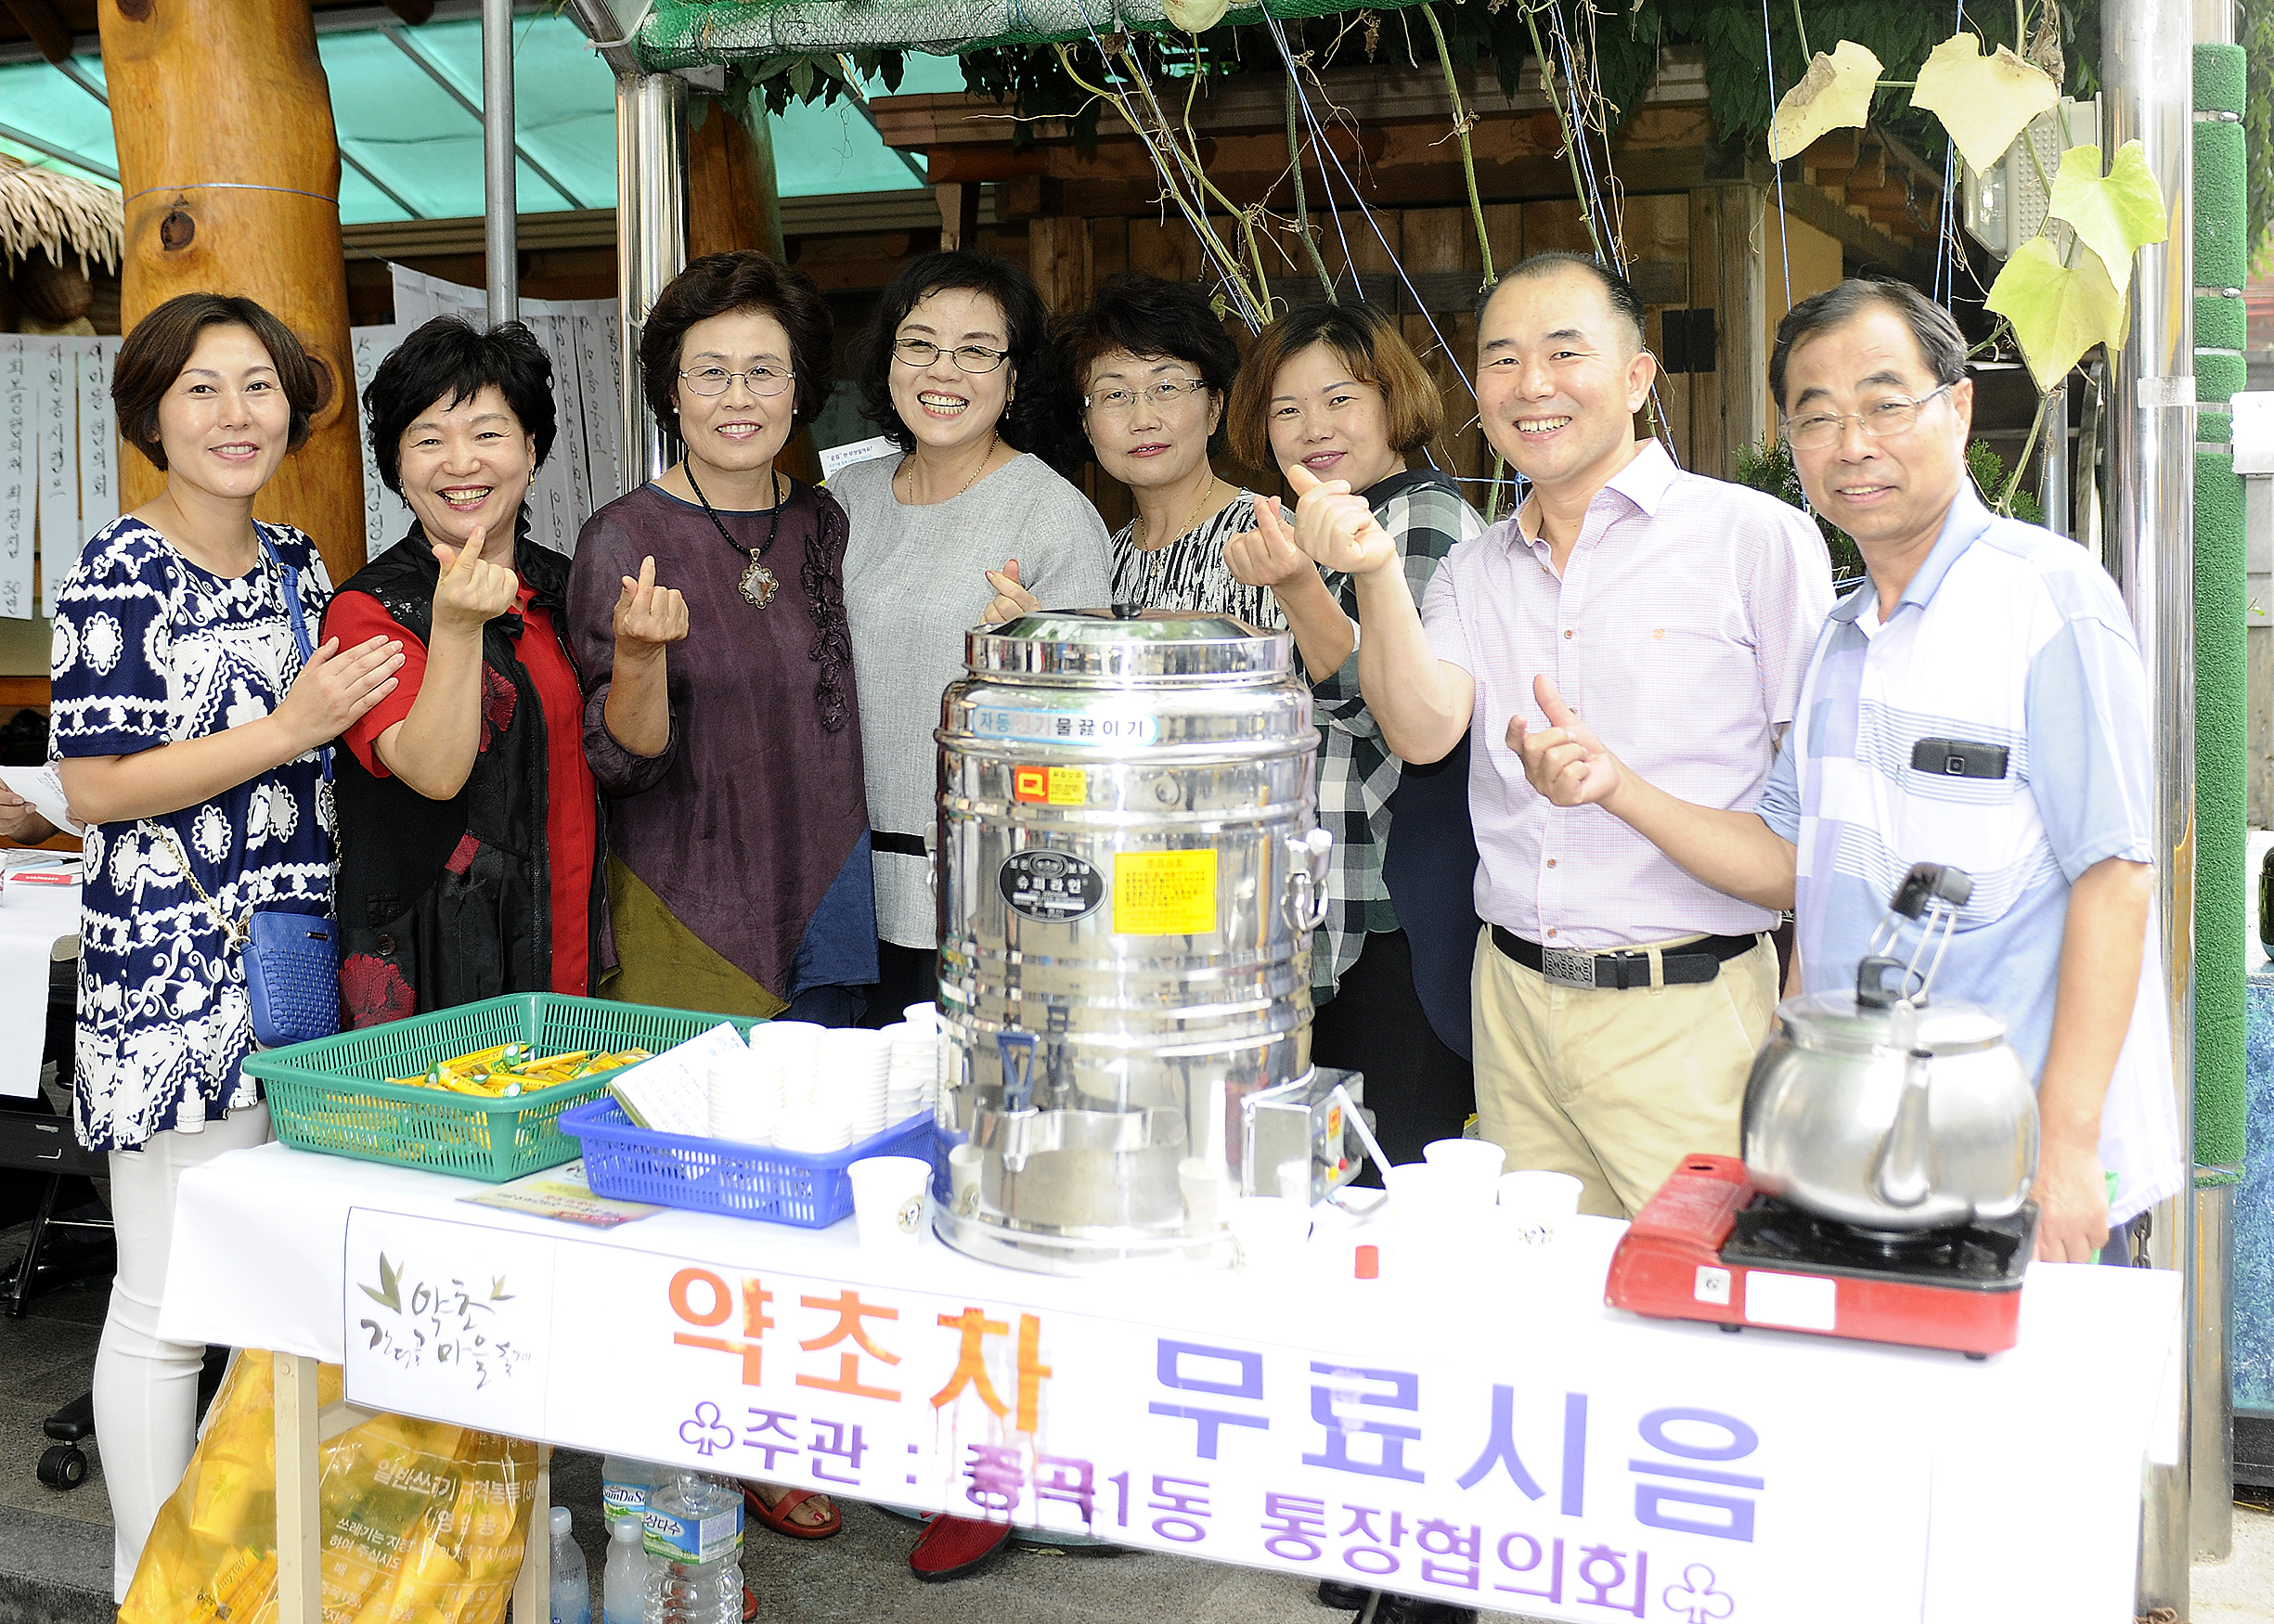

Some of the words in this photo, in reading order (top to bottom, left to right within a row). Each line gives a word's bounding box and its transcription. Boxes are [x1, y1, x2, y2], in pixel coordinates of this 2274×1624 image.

[980, 712, 1011, 733] 자동
[412, 1279, 496, 1337] 약초
[668, 1268, 1052, 1435] 약초차
[646, 1514, 681, 1536] 삼다수
[743, 1407, 869, 1486] 주관
[1260, 1491, 1648, 1618] 통장협의회
[336, 1518, 384, 1545] 쓰레기는
[329, 1535, 355, 1553] 하여
[356, 1542, 403, 1570] 주십시오
